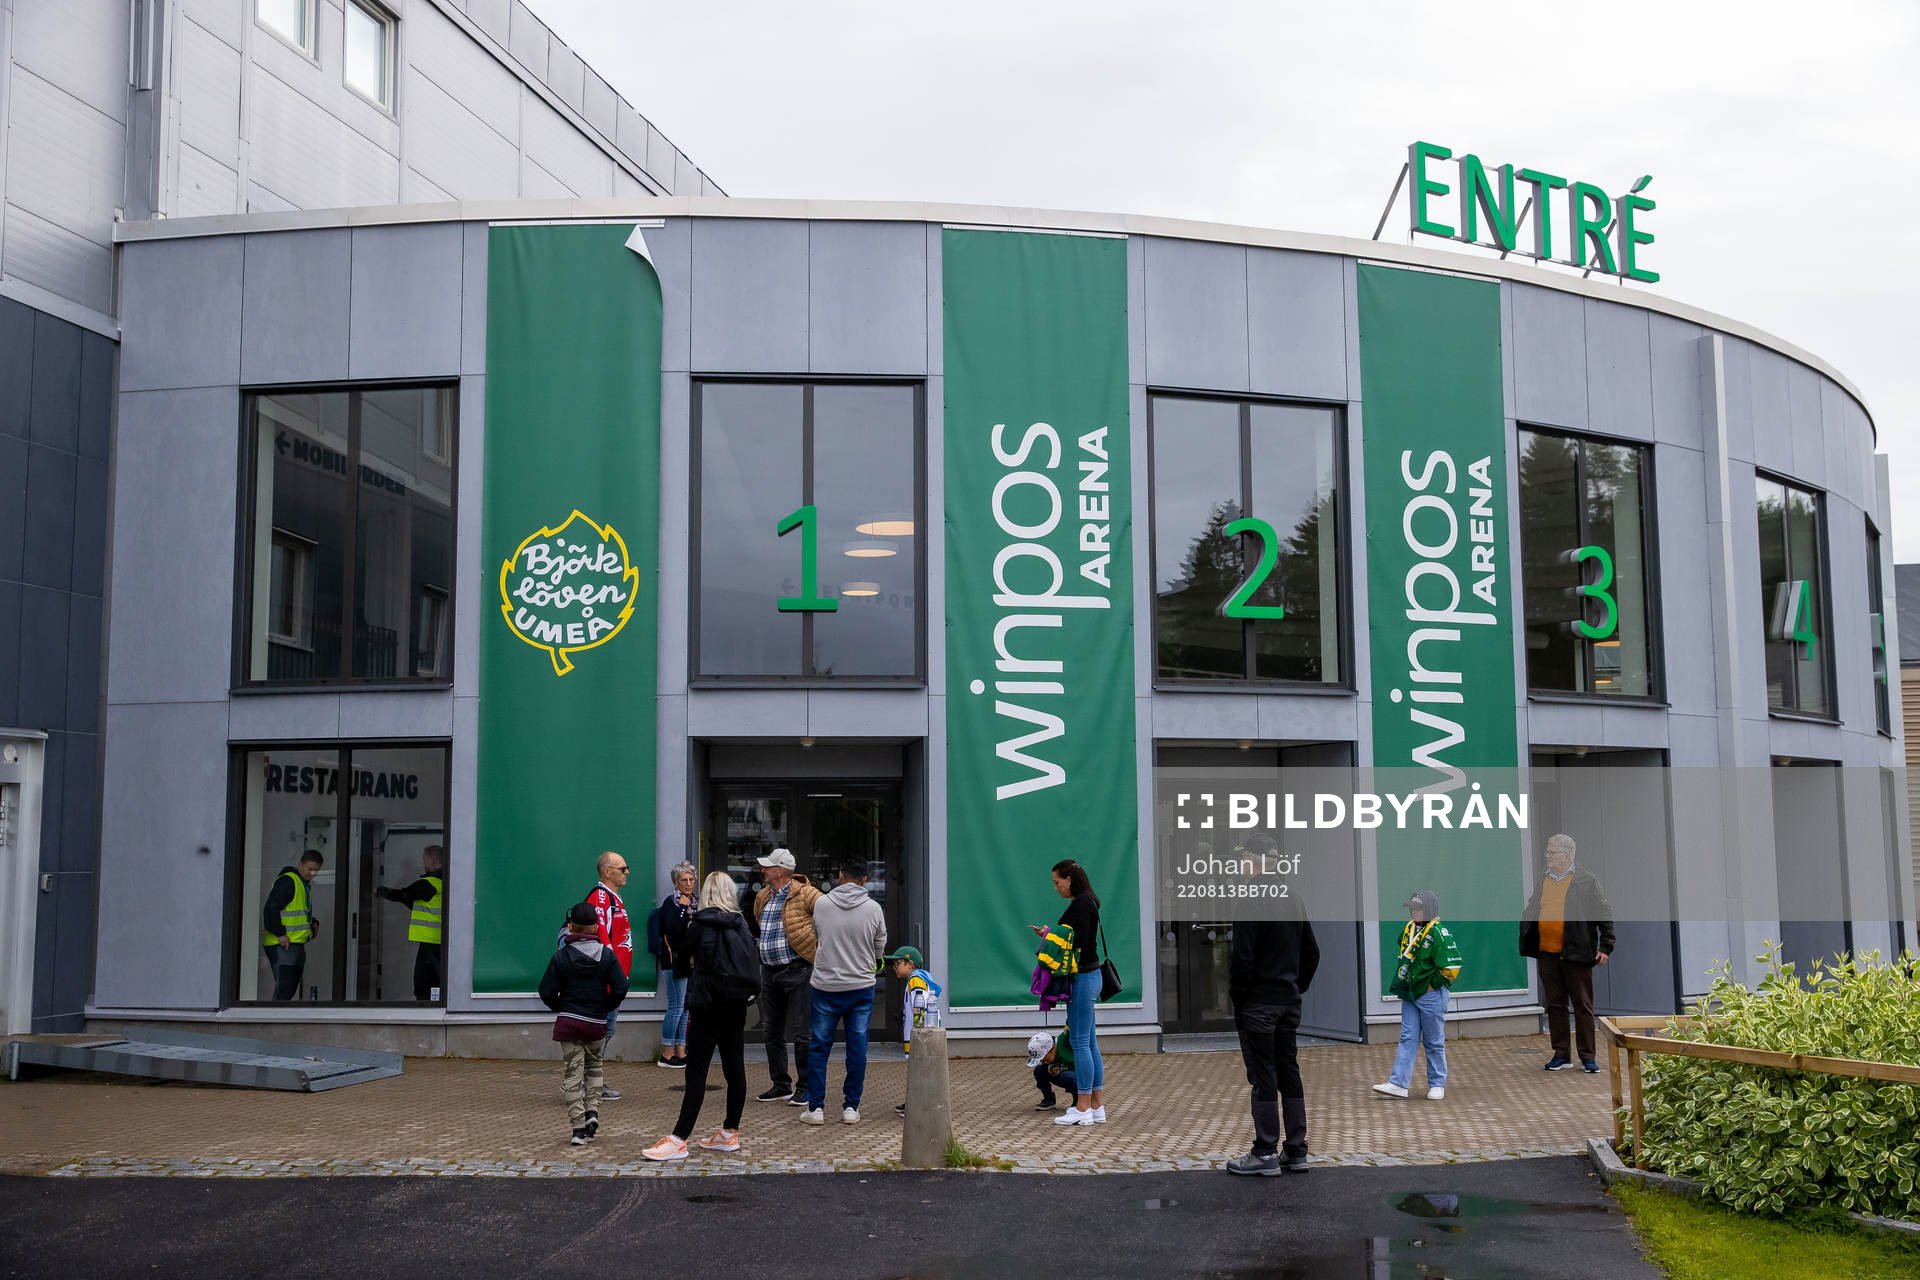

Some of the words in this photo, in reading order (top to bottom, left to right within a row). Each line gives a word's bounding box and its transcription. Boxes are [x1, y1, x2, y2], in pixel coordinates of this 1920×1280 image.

[1408, 141, 1660, 283] ENTRÉ
[777, 505, 838, 612] 1
[1078, 425, 1111, 589] ARENA
[1468, 456, 1497, 606] ARENA
[512, 576, 627, 609] löven
[521, 538, 623, 585] Björk
[970, 422, 1111, 801] winpos
[1222, 517, 1284, 619] 2
[1571, 545, 1618, 639] 3
[514, 606, 616, 645] UMEÅ
[1390, 450, 1497, 803] winpos
[1784, 579, 1816, 661] 4
